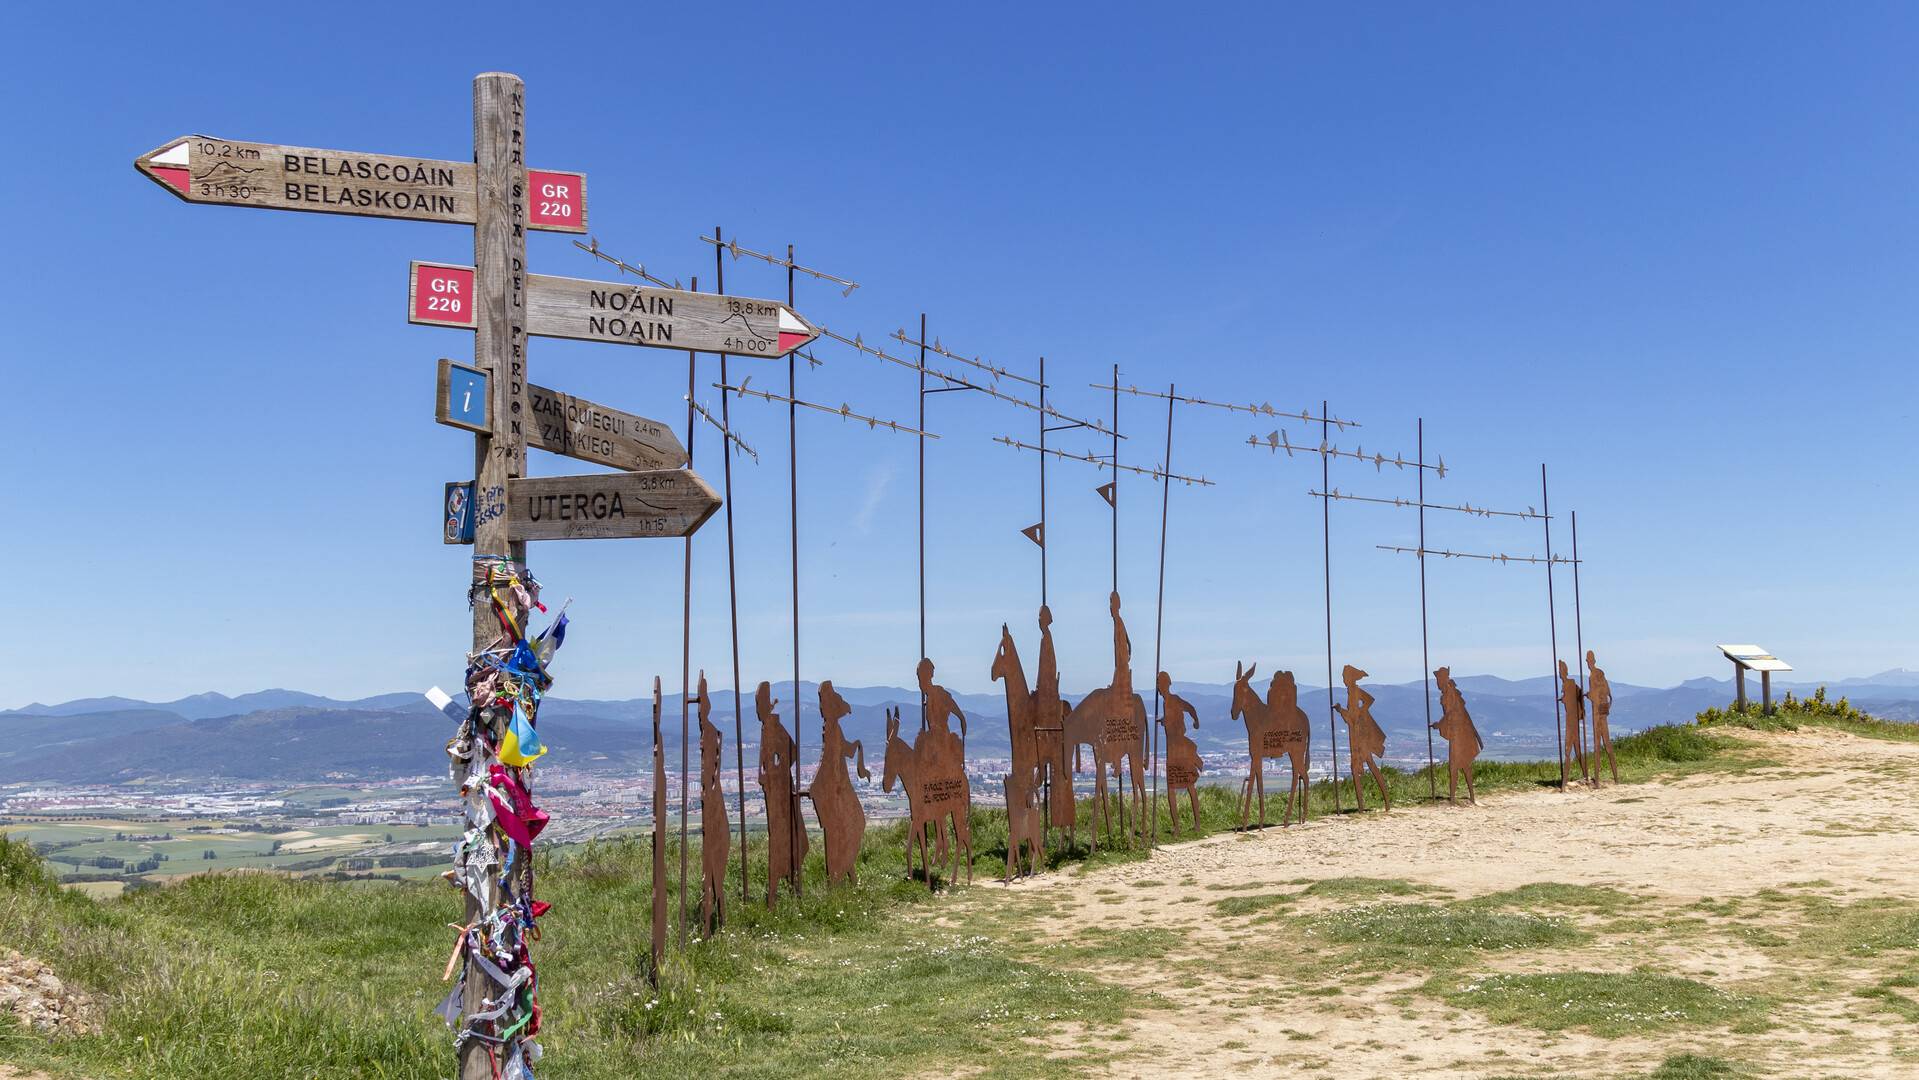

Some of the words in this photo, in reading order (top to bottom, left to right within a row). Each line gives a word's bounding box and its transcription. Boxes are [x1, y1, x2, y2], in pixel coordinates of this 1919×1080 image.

[236, 145, 261, 160] km
[284, 154, 454, 187] BELASCOÁIN
[201, 182, 211, 196] 3
[215, 184, 225, 197] h
[285, 182, 455, 214] BELASKOAIN
[541, 183, 569, 199] GR
[539, 202, 572, 217] 220
[431, 278, 460, 295] GR
[512, 257, 522, 308] DEL
[427, 296, 461, 313] 220
[590, 287, 673, 316] NOÁIN
[757, 303, 777, 317] km
[589, 316, 673, 342] NOAIN
[724, 337, 732, 349] 4
[735, 338, 744, 350] h
[511, 325, 522, 436] PERDON
[533, 394, 625, 437] ZARQUIEGUI
[649, 424, 661, 438] km
[659, 477, 676, 489] km
[528, 491, 625, 522] UTERGA
